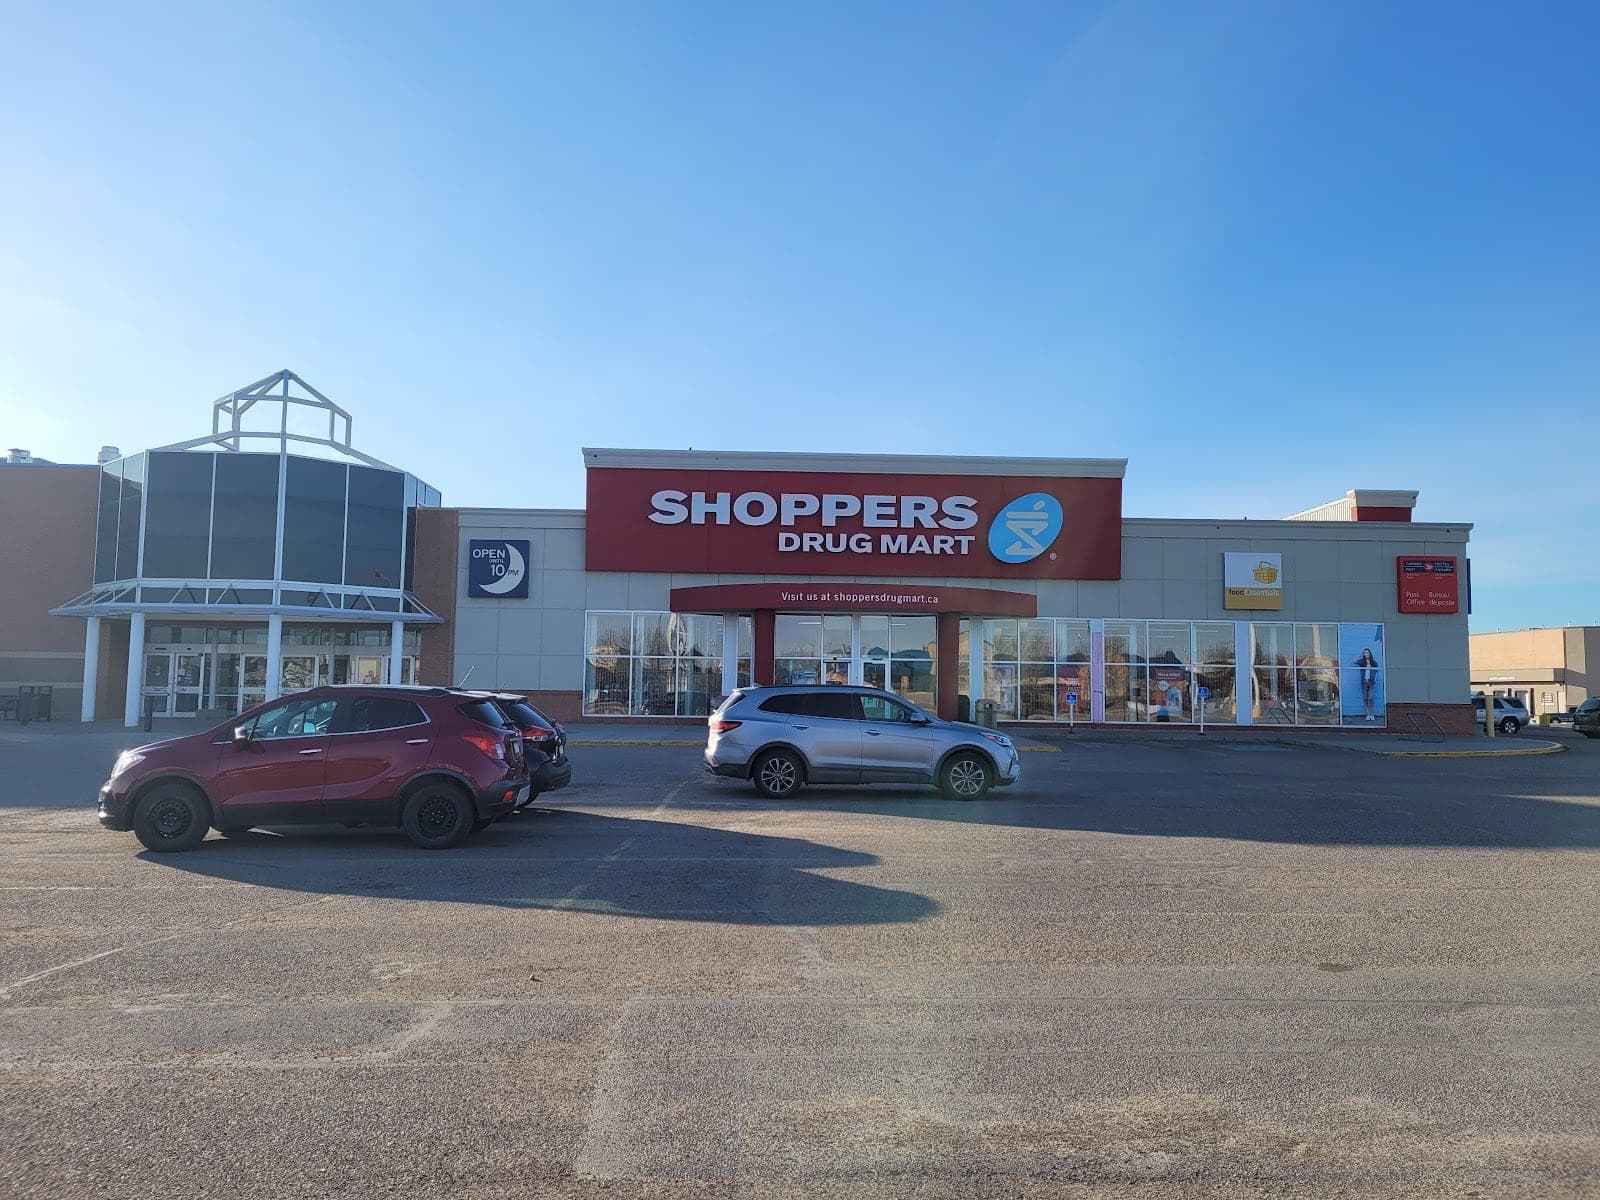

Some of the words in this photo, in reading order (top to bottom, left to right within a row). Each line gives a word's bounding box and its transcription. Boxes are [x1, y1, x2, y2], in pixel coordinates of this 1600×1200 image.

[647, 489, 979, 530] SHOPPERS
[778, 532, 873, 554] DRUG
[880, 534, 976, 555] MART
[472, 548, 506, 559] OPEN
[490, 563, 505, 577] 10
[781, 591, 804, 601] Visit
[806, 593, 818, 601] us
[820, 592, 831, 601] at
[833, 591, 939, 604] shoppersdrugmart.ca
